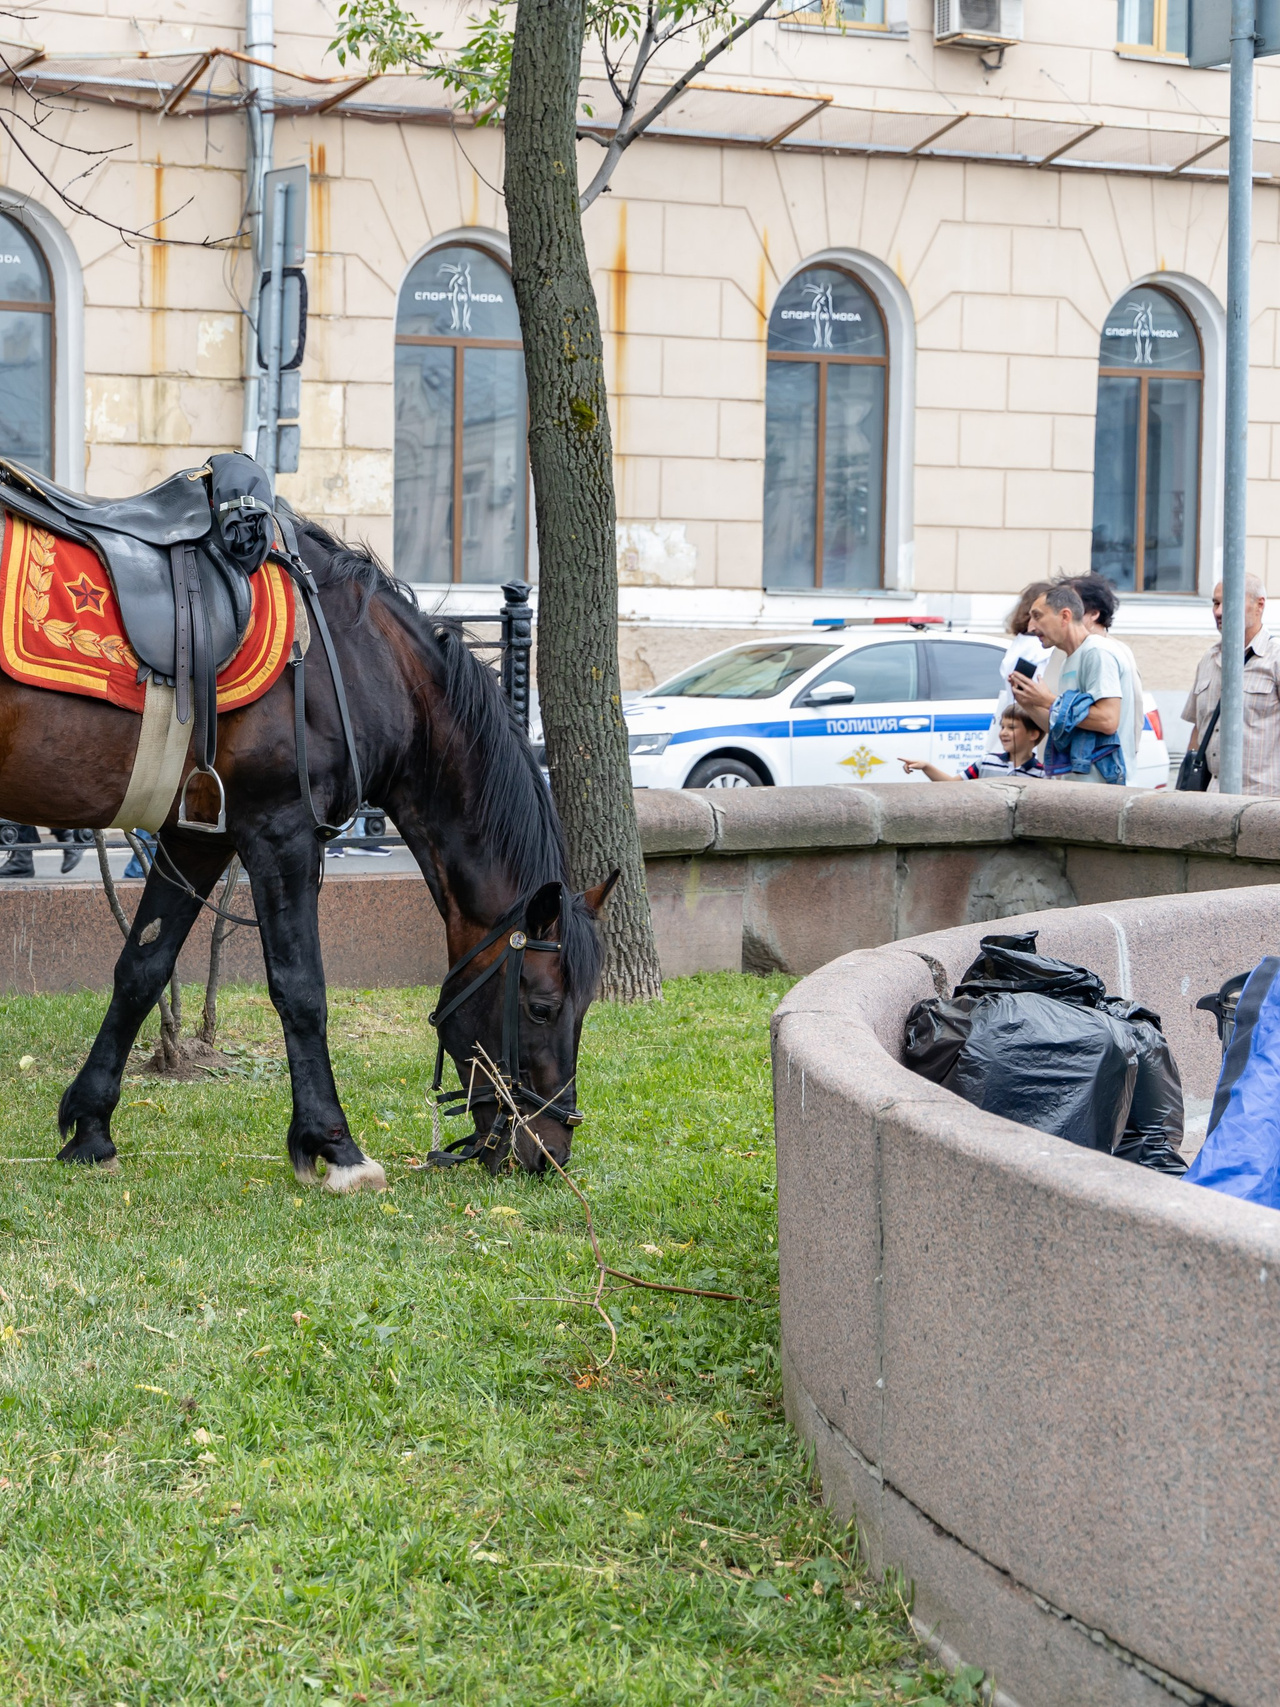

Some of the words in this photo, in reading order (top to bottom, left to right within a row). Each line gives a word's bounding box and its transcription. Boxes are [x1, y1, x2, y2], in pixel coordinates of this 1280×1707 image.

[414, 291, 453, 302] СПОРТ
[781, 310, 816, 320] СПОРТ
[1105, 327, 1137, 337] СПОРТ
[826, 718, 899, 734] ПОЛИЦИЯ
[964, 732, 984, 742] ДПС
[954, 744, 972, 752] УВД
